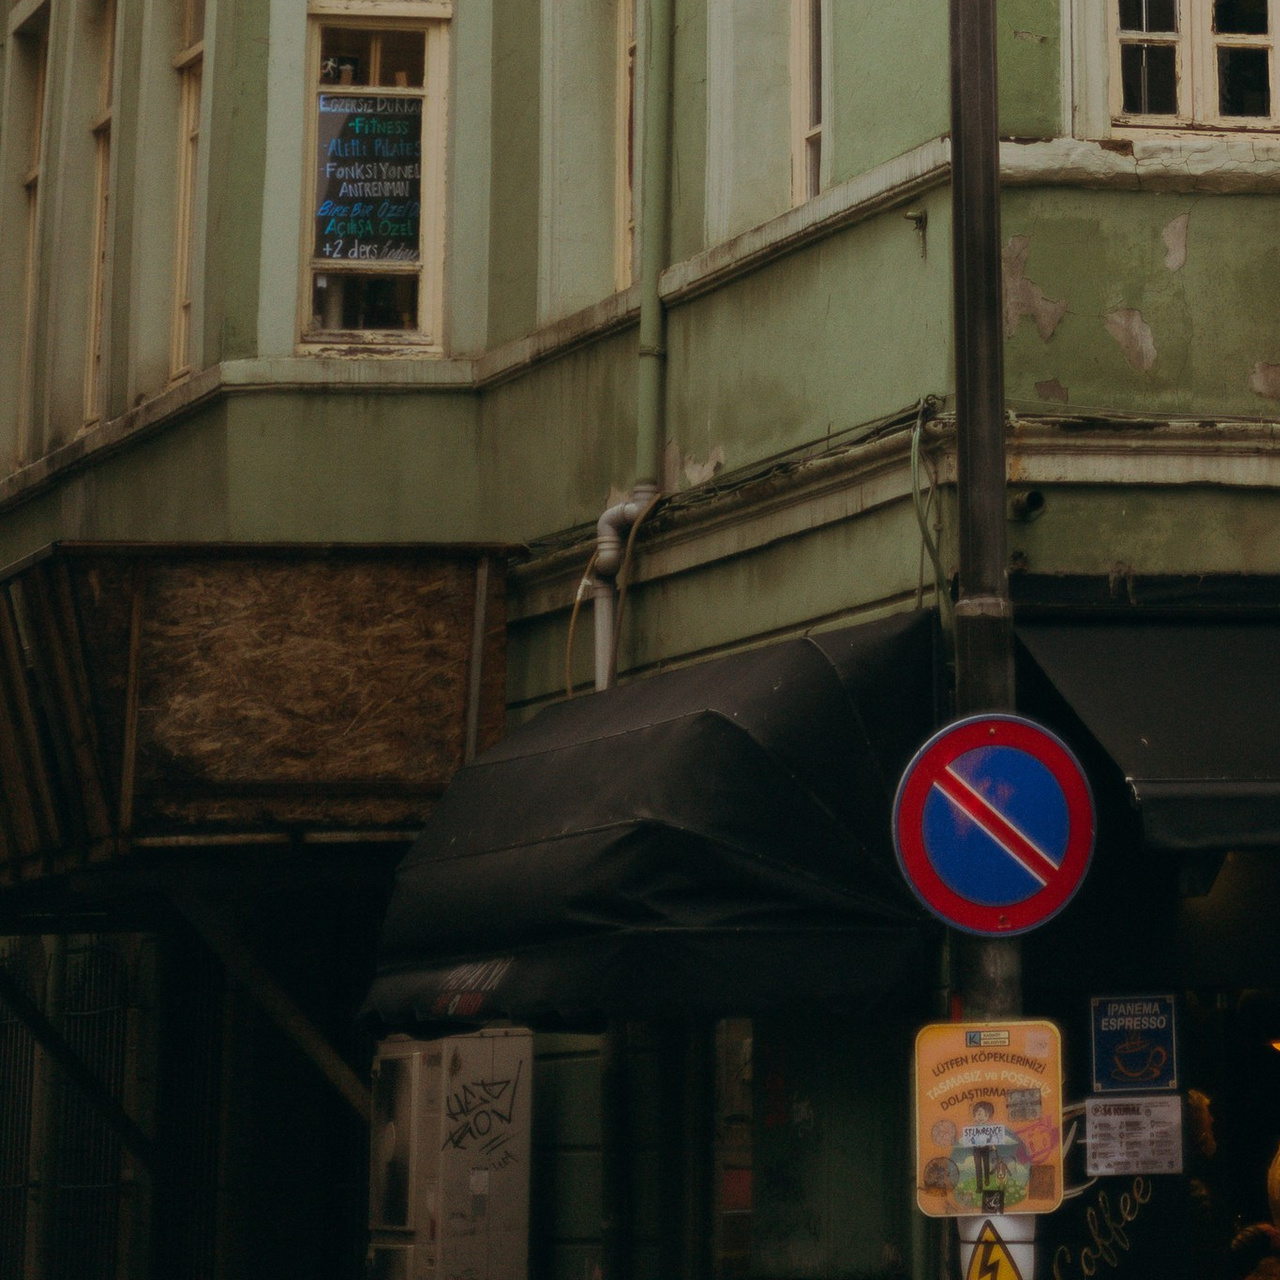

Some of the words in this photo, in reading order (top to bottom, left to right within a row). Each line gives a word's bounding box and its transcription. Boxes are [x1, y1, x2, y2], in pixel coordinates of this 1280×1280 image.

[322, 239, 344, 258] +2
[1101, 1016, 1168, 1031] ESPRESSO
[931, 1055, 969, 1078] LÜTFEN
